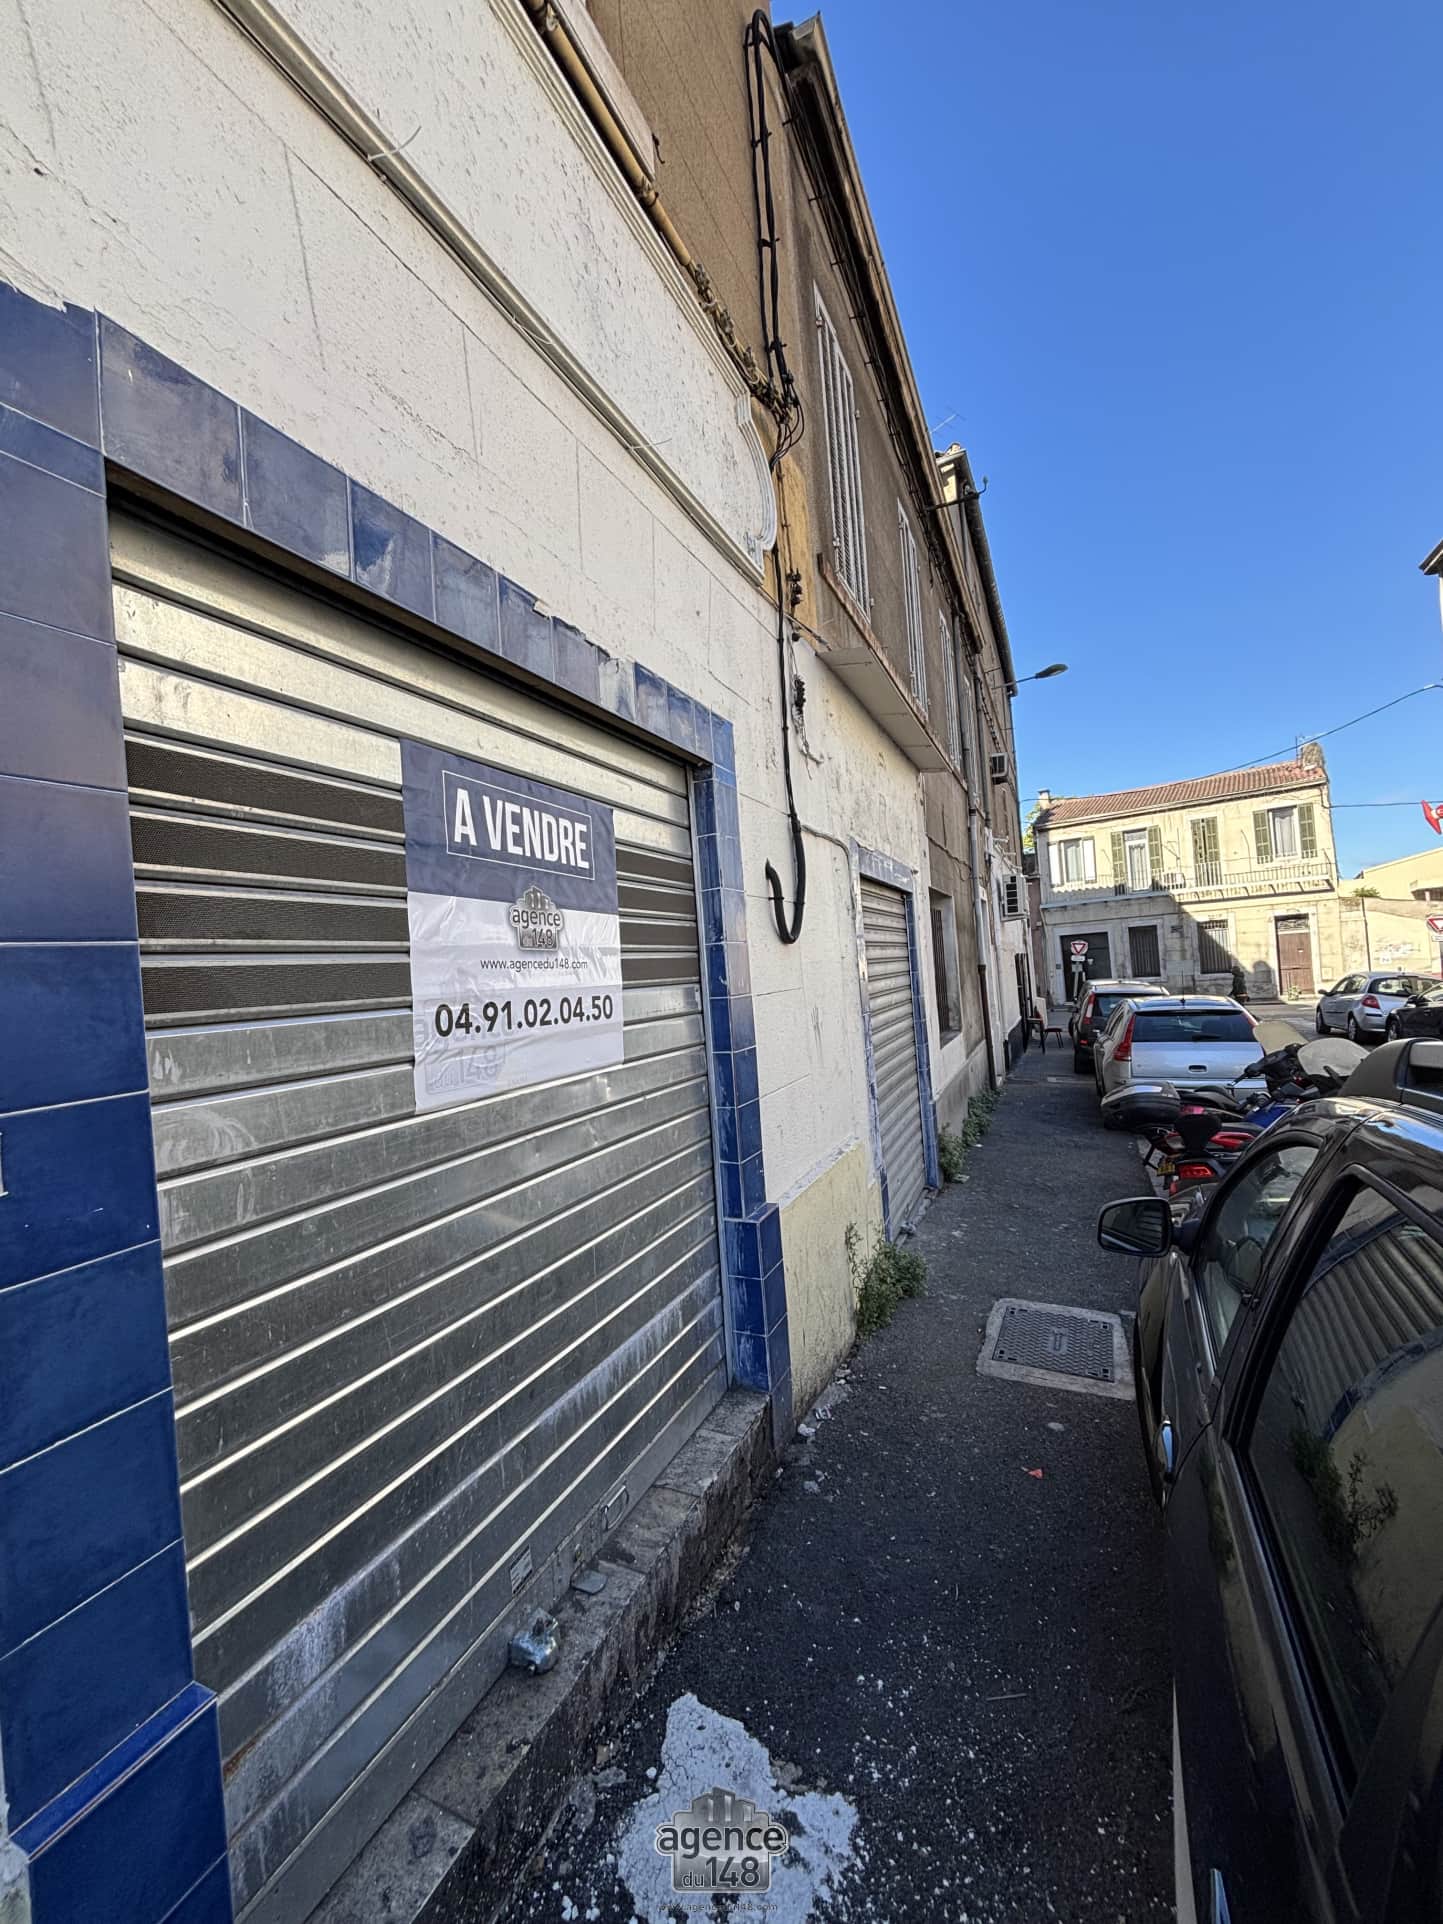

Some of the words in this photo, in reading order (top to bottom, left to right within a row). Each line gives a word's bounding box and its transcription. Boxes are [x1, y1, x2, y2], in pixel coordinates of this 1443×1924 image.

[454, 788, 477, 847] A
[483, 794, 590, 869] VENDRE
[512, 909, 561, 929] agence
[532, 927, 554, 946] 148
[480, 958, 588, 972] www.agencedu148.com
[434, 994, 614, 1038] 04.91.02.04.50
